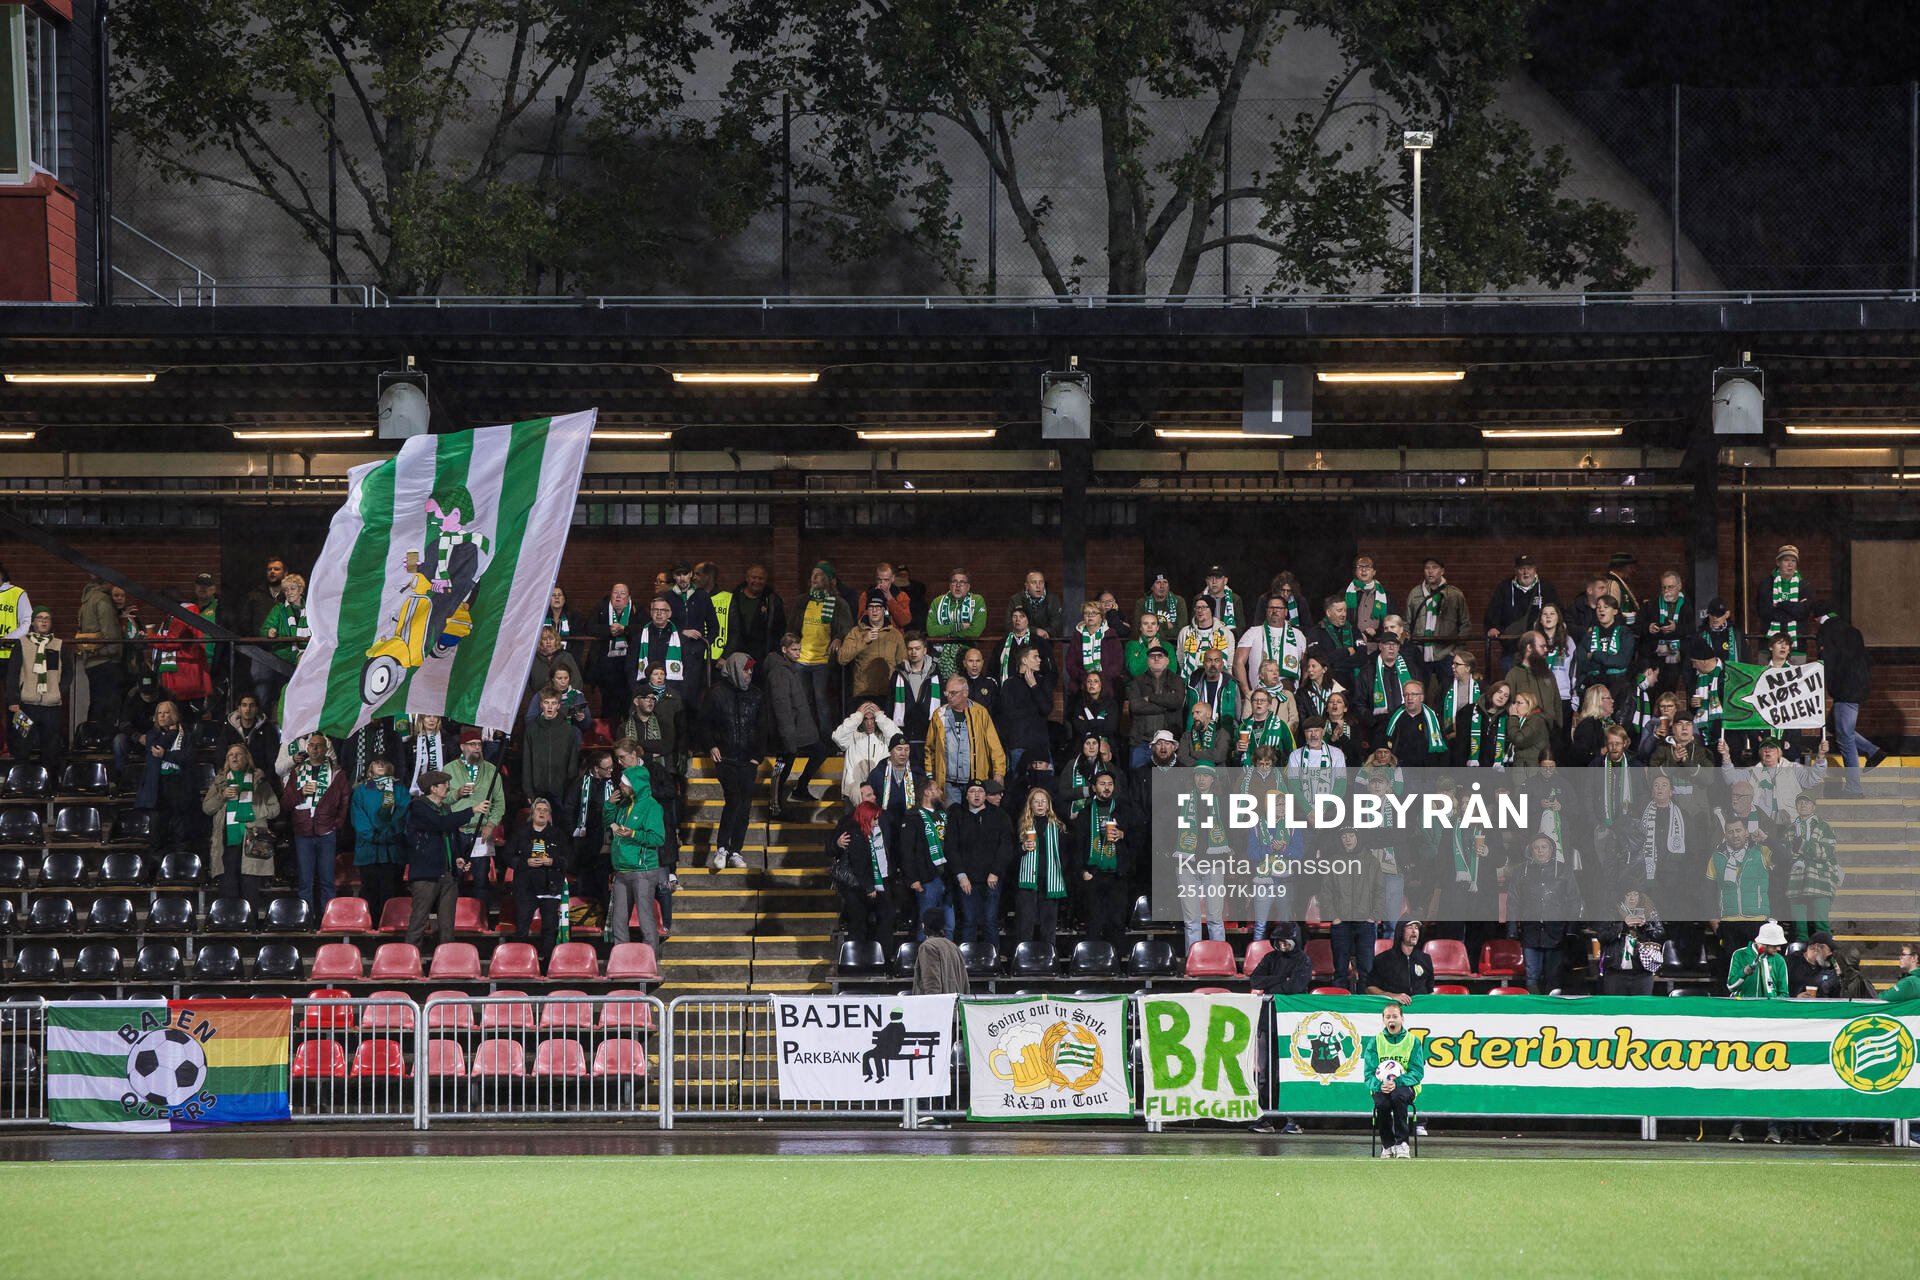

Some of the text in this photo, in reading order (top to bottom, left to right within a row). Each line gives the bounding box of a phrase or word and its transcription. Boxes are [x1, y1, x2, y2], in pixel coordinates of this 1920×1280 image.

[1766, 667, 1802, 690] NU
[1804, 672, 1822, 692] VI
[1770, 696, 1822, 725] BAJEN!
[118, 1007, 217, 1044] BAJEN
[780, 1004, 883, 1028] BAJEN
[988, 1003, 1107, 1037] Going out in Style
[1144, 1000, 1251, 1097] BR
[121, 1091, 216, 1119] QUEERS
[1003, 1091, 1109, 1110] R&D on Tour
[1146, 1096, 1258, 1119] FLAGGAN
